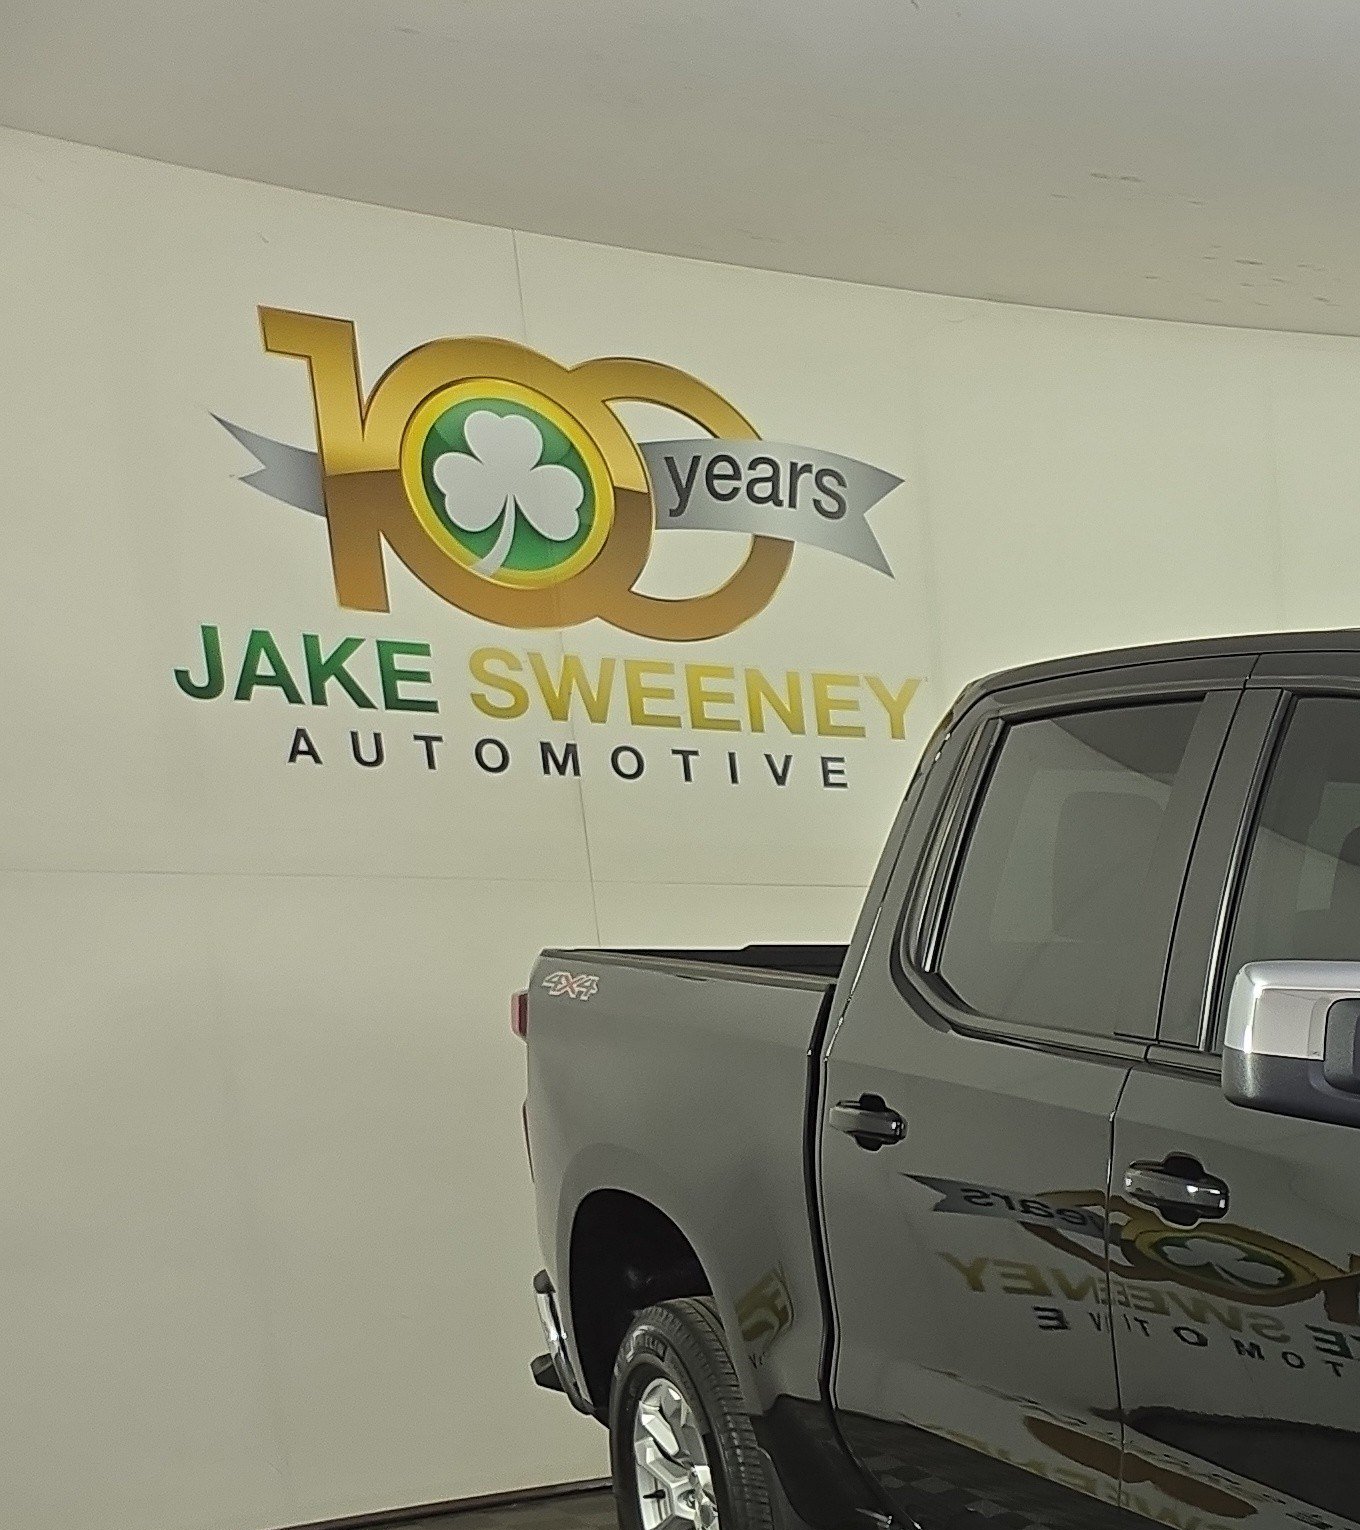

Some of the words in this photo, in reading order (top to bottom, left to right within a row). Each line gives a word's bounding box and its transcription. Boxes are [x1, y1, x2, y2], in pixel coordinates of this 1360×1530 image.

[256, 305, 796, 642] 100
[664, 452, 849, 520] years
[174, 624, 440, 714] JAKE
[469, 646, 923, 741] SWEENEY
[287, 726, 850, 790] AUTOMOTIVE
